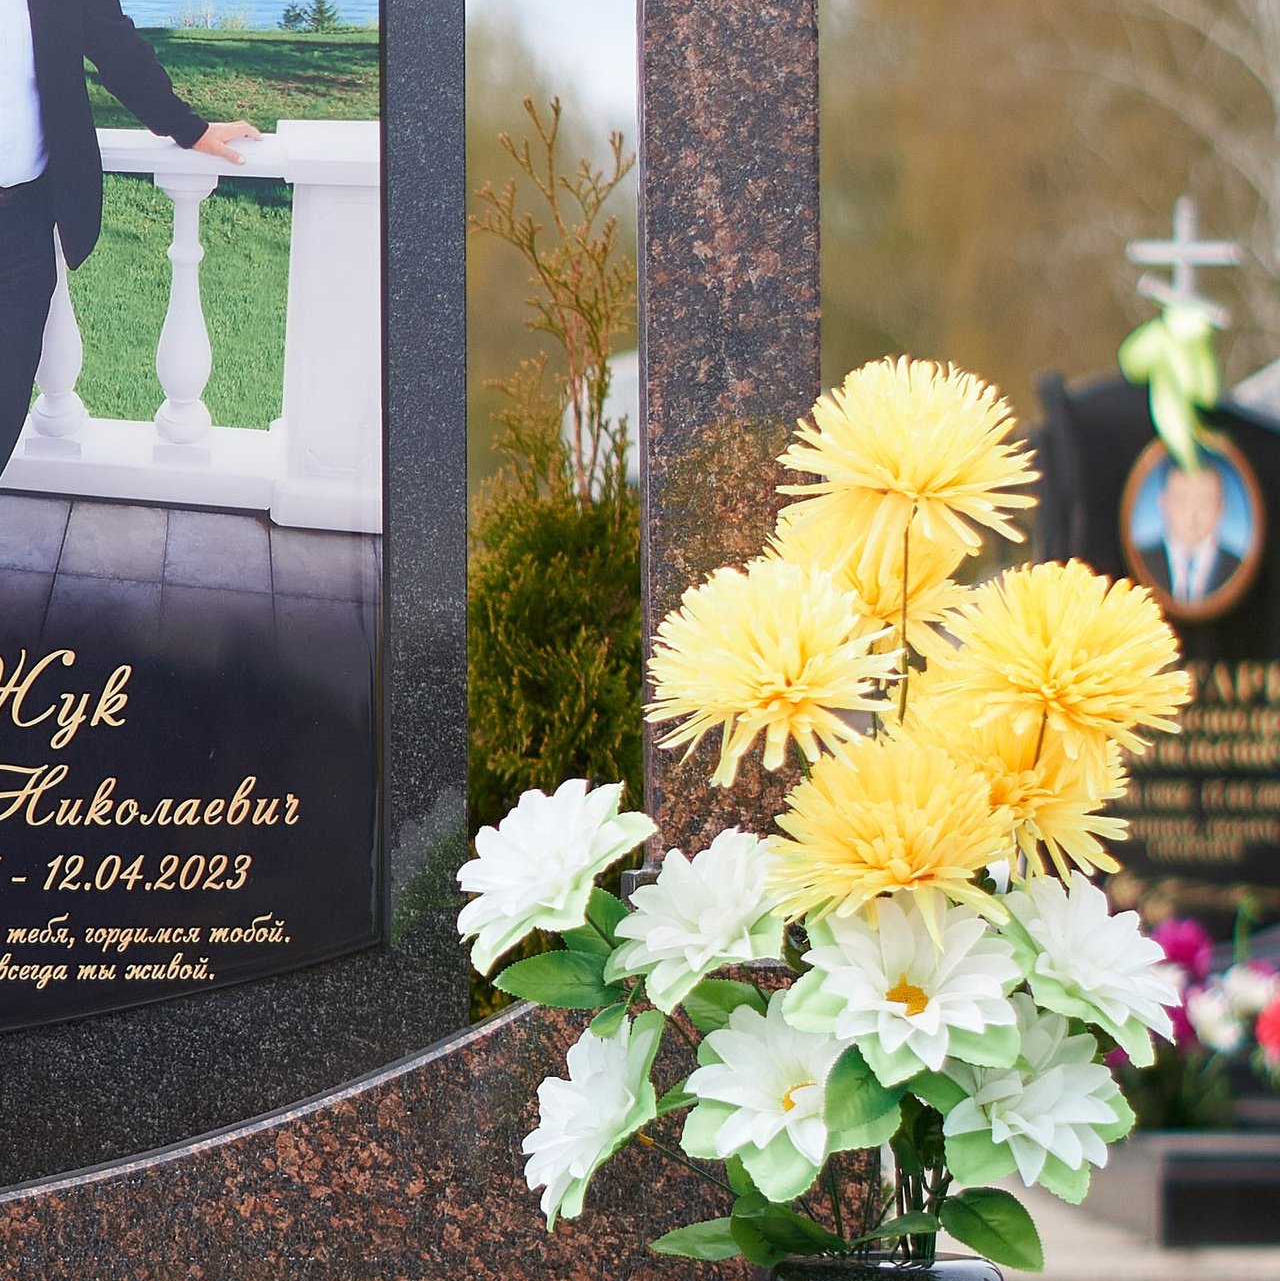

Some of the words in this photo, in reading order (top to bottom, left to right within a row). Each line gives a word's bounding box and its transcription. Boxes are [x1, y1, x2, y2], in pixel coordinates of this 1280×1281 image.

[43, 854, 253, 892] 12.04.2023
[6, 913, 77, 950] тебя,
[85, 926, 203, 952] гордимся
[208, 913, 292, 944] тобой.
[77, 964, 119, 982] ты
[123, 951, 216, 982] живой.
